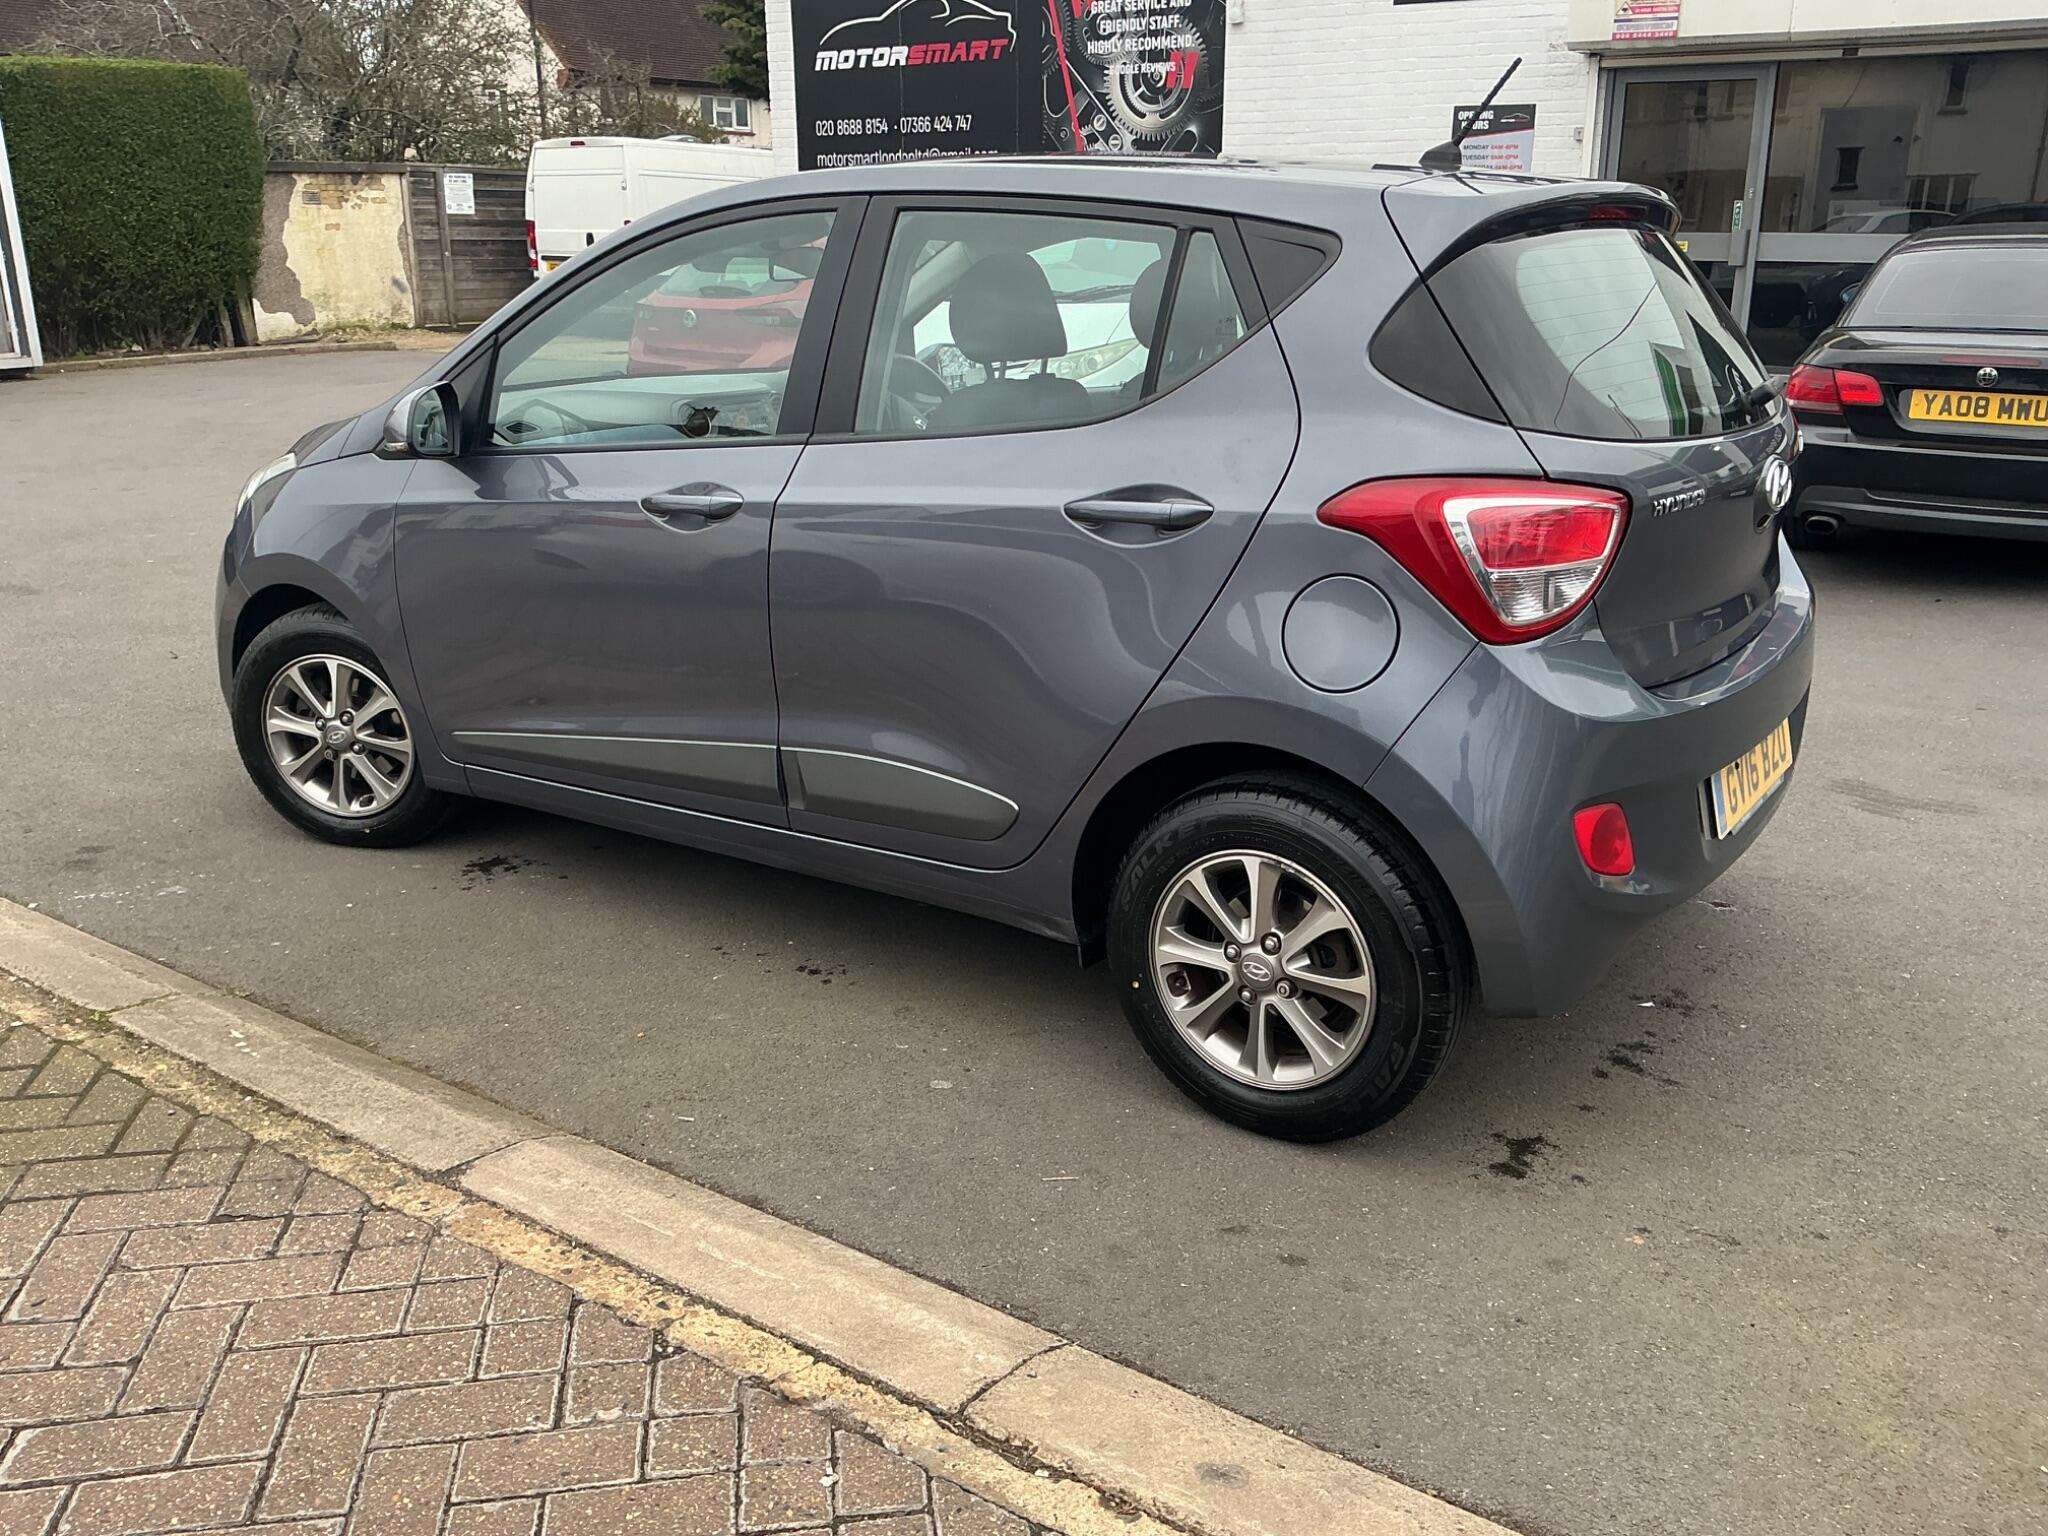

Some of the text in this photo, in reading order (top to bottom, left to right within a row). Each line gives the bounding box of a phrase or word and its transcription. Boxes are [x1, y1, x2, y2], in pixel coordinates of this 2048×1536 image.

[1091, 0, 1192, 14] GREAT SERVICE AND
[1100, 14, 1182, 33] FRIENDLY STAFF.
[1087, 34, 1195, 54] HIGHLY RECOMMEND.
[814, 39, 1009, 71] MOTORSMART
[1141, 61, 1176, 74] REVIEWS
[815, 114, 972, 136] 020 8688 8154 07366 424 747
[1462, 153, 1489, 161] TUESDAY
[1923, 393, 2048, 422] YA08 MWU
[1652, 488, 1706, 518] HYUNDAI
